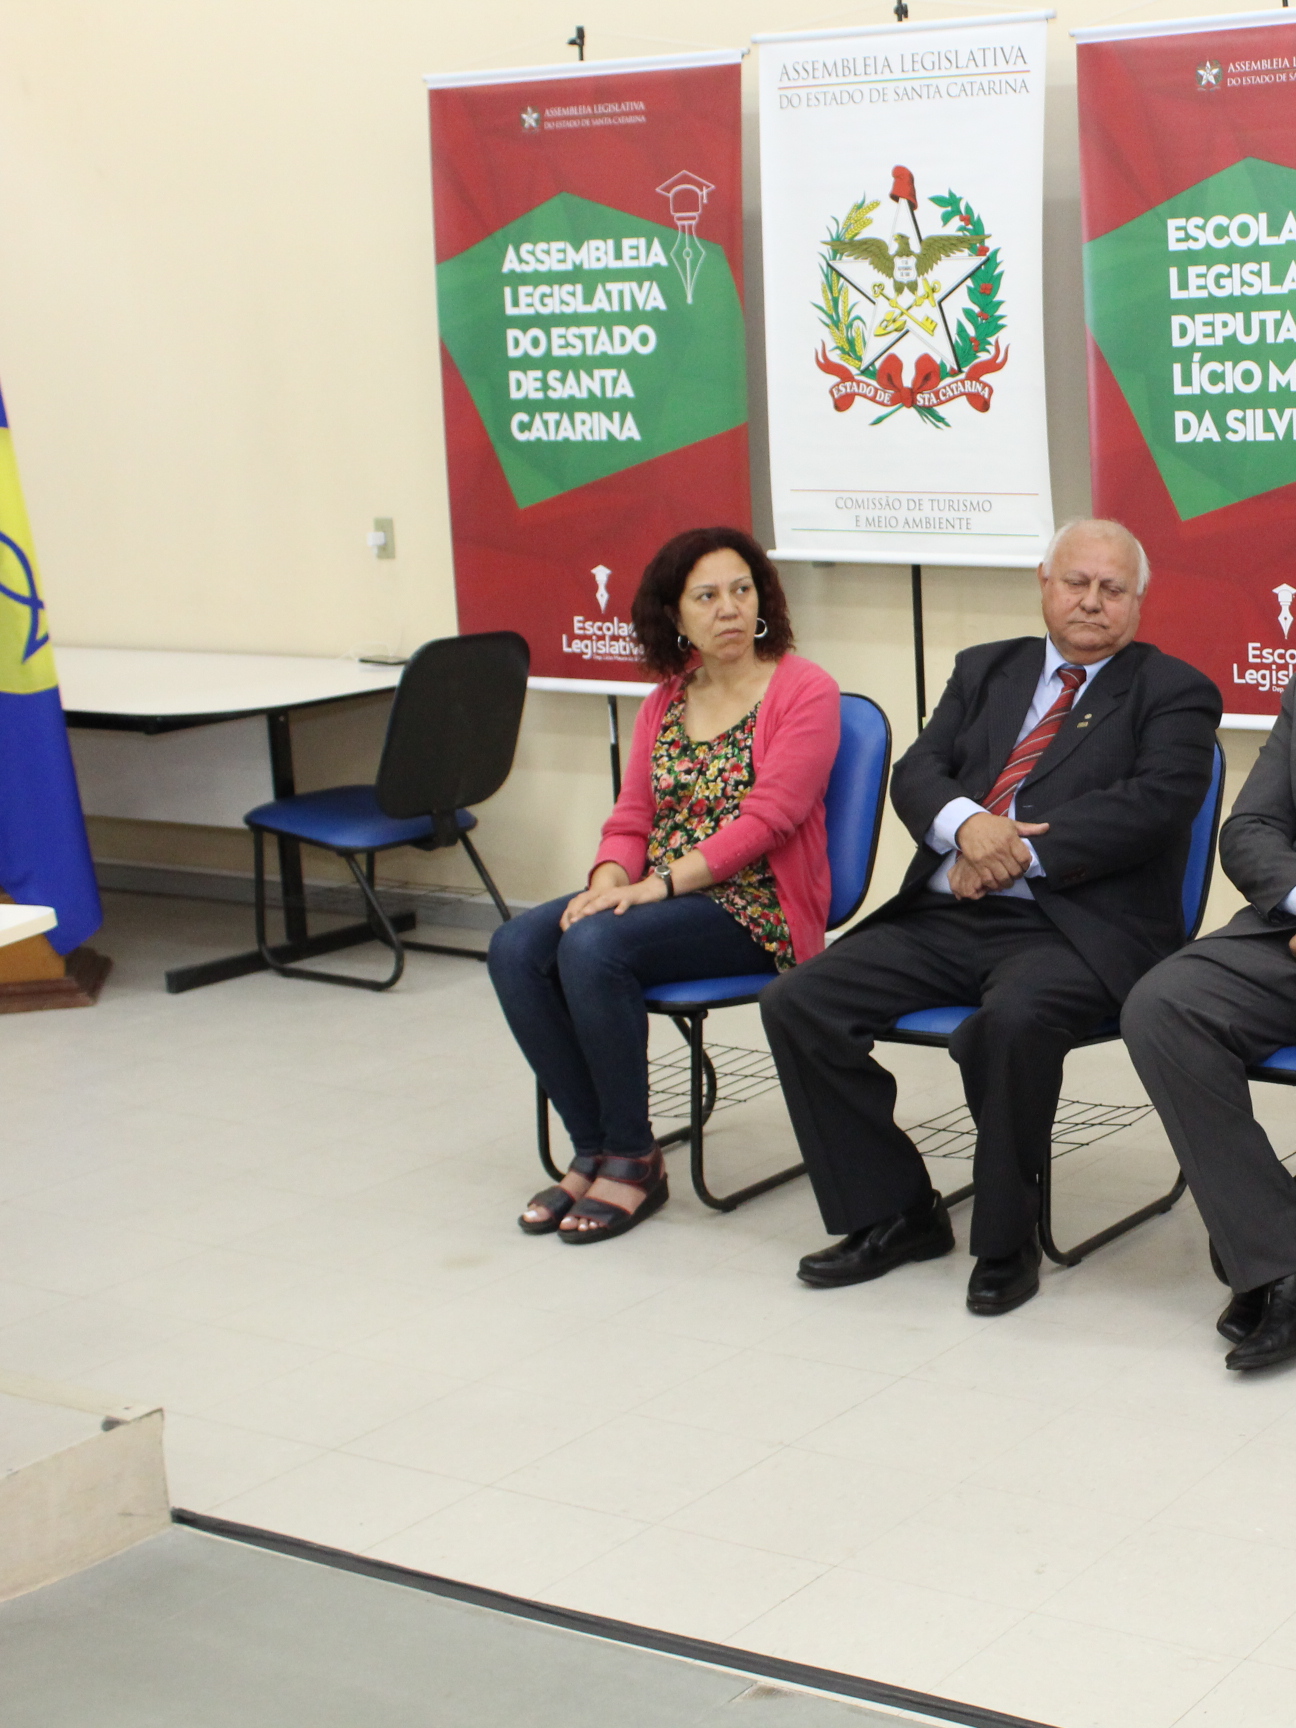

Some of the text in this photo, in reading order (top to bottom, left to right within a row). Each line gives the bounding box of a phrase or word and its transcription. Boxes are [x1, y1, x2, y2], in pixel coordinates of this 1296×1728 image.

[779, 45, 1028, 82] ASSEMBLEIA LEGISLATIVA
[1227, 57, 1290, 73] ASSEMBLEIA
[779, 78, 1030, 110] DO ESTADO DE SANTA CATARINA
[1227, 77, 1241, 87] DO
[1242, 74, 1274, 85] ESTADO
[1276, 73, 1287, 83] DE
[594, 101, 645, 114] LEGISLATIVA
[501, 237, 668, 273] ASSEMBLEIA
[504, 281, 667, 315] LEGISLATIVA
[506, 324, 657, 358] DO ESTADO
[508, 369, 635, 399] DE SANTA
[1173, 352, 1262, 395] LÍCIO
[832, 380, 990, 405] ESTADO DE STA. CATARINA
[511, 411, 641, 441] CATARINA
[1174, 409, 1221, 443] DA
[835, 496, 992, 512] COMISSÃO DE TURISMO
[855, 515, 972, 530] E MEIO AMBIENTE
[573, 616, 629, 637] Escola
